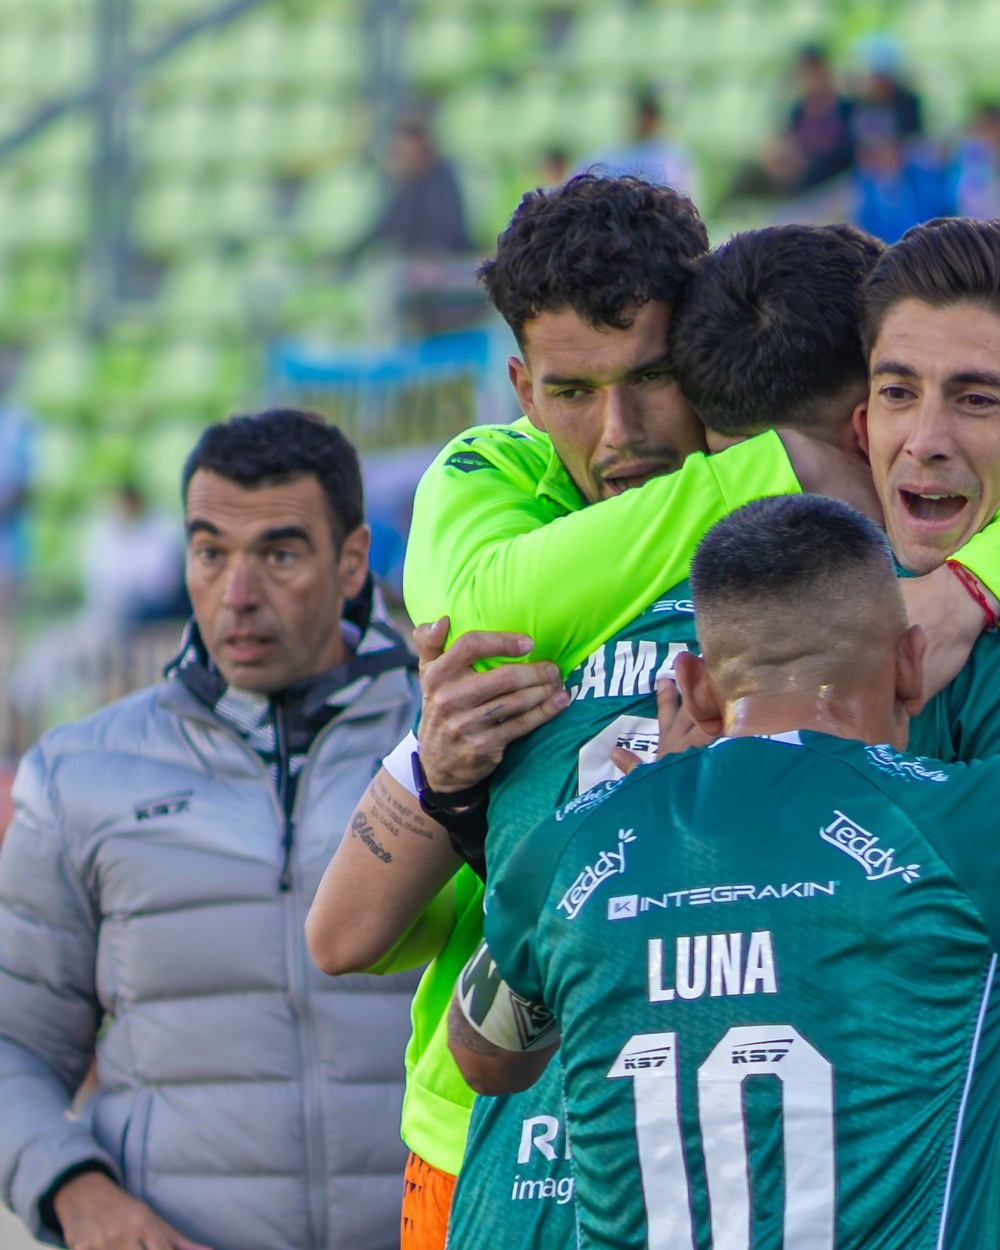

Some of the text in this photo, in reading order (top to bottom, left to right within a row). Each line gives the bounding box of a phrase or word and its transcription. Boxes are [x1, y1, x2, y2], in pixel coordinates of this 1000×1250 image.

[819, 810, 905, 881] Teddy
[556, 841, 625, 919] Teddy
[640, 880, 835, 912] INTEGRAKIN
[648, 931, 777, 1002] LUNA
[624, 1055, 667, 1070] KS7
[731, 1049, 790, 1064] KS7
